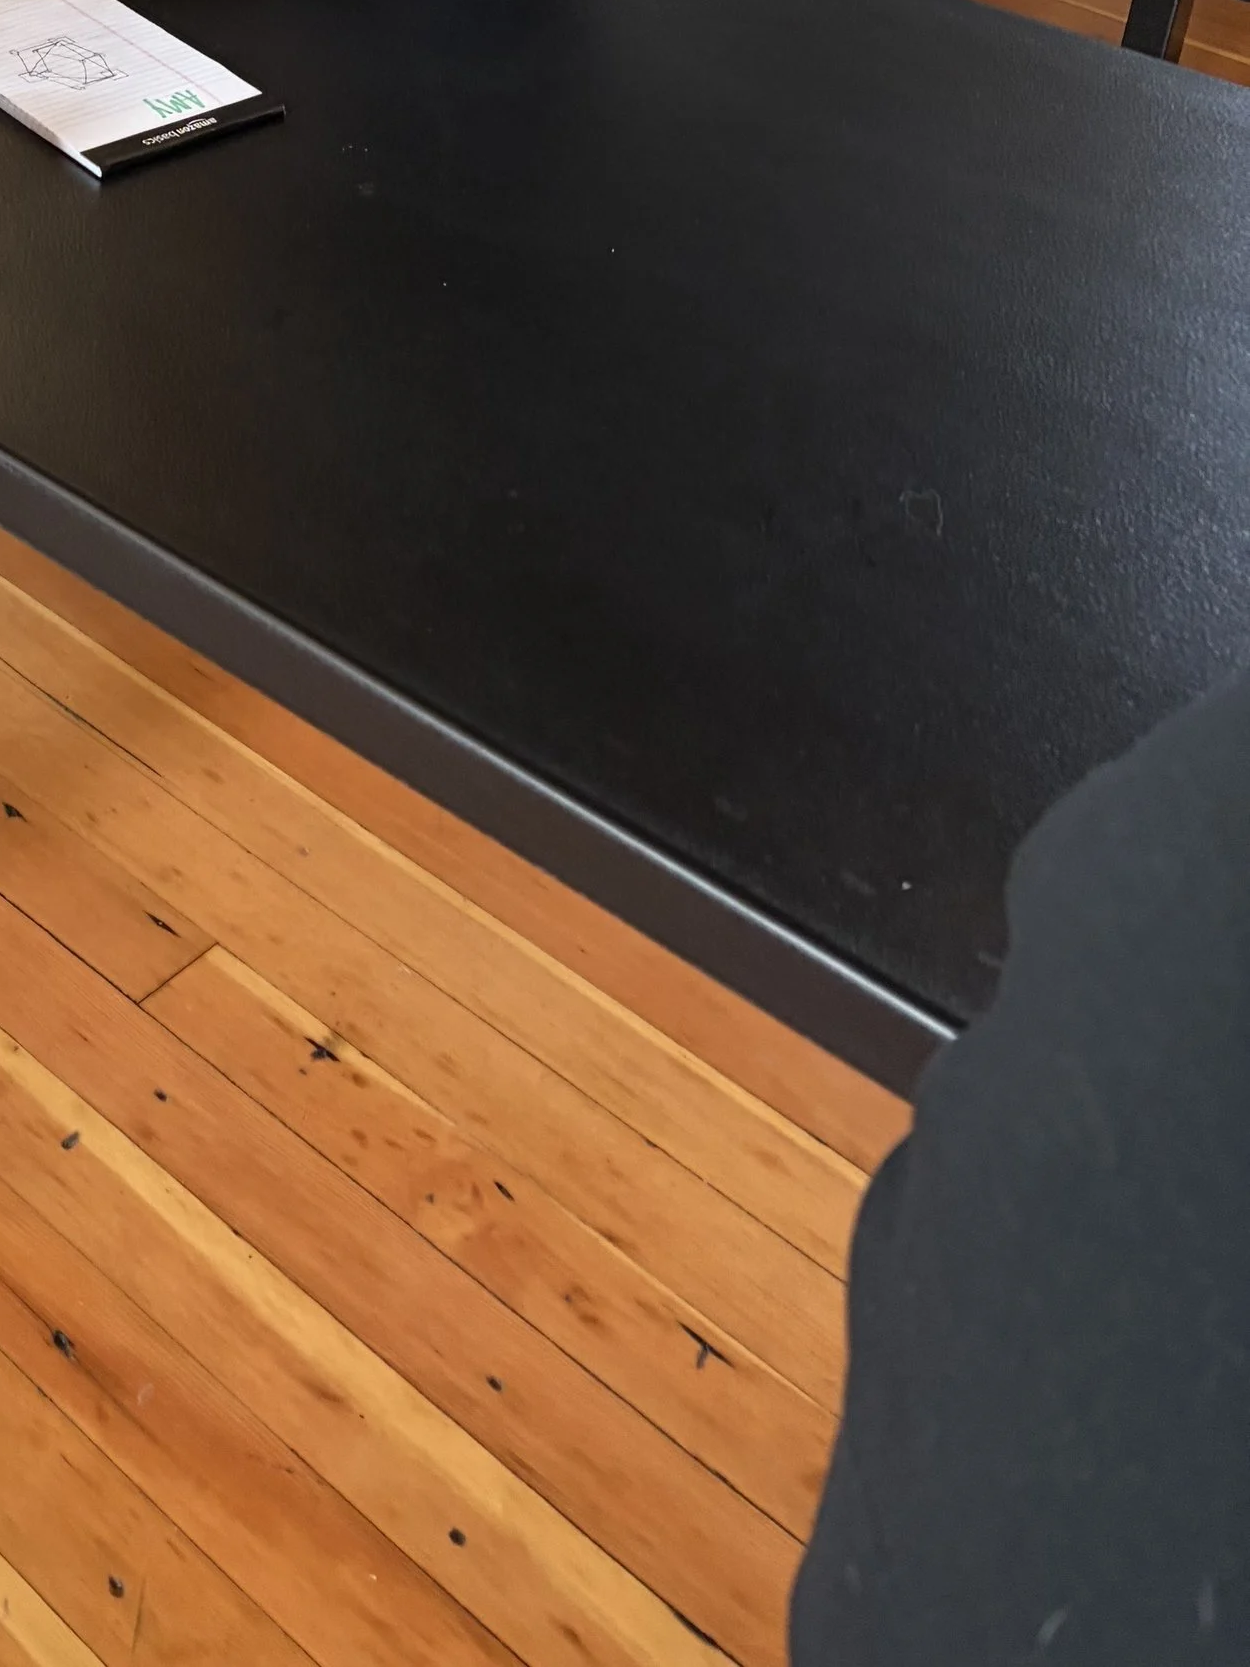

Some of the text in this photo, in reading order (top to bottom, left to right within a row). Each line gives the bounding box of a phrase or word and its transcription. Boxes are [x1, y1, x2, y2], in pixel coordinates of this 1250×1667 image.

[143, 90, 205, 118] AMY
[142, 117, 217, 145] amazon basics
